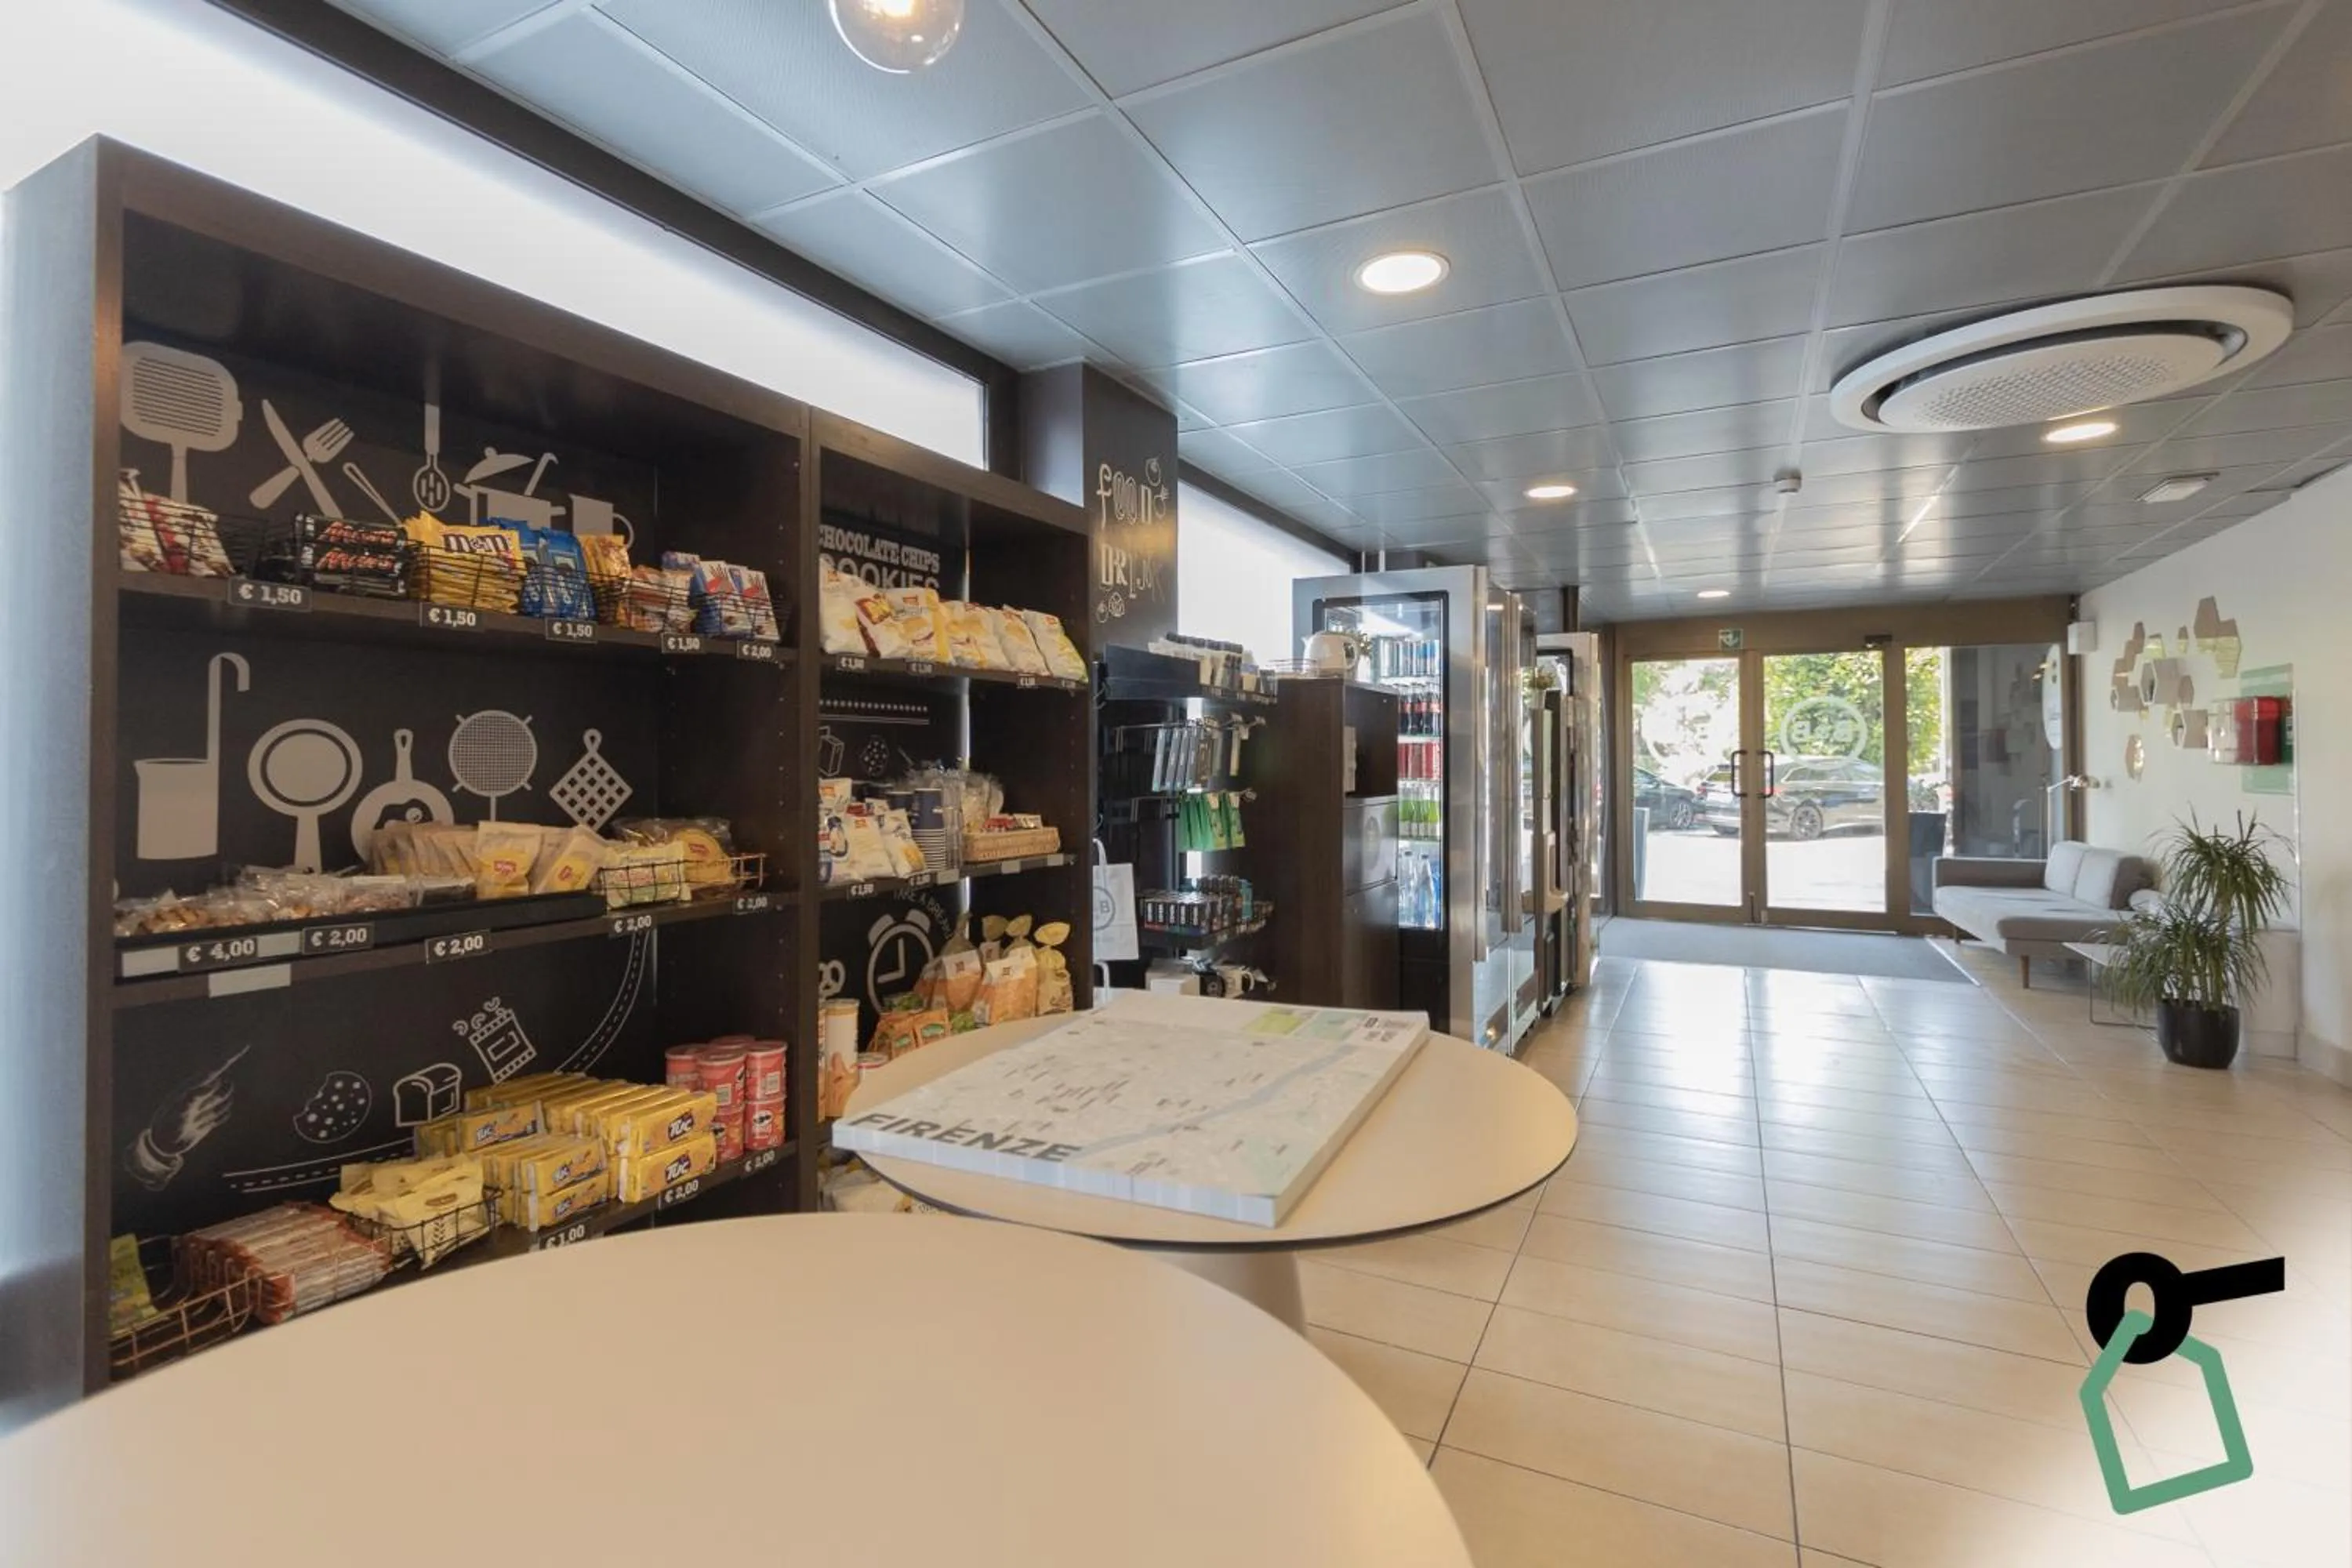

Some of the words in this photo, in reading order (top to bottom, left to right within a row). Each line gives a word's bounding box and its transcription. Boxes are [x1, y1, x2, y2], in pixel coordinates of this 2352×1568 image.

[819, 524, 899, 564] CHOCOLATE
[901, 544, 940, 575] CHIPS
[238, 583, 253, 599] €
[260, 586, 302, 605] 1,50
[429, 608, 440, 622] €
[444, 609, 476, 627] 1,50
[553, 622, 562, 634] €
[566, 623, 592, 638] 1,50
[667, 637, 676, 649] €
[614, 920, 622, 933] €
[626, 915, 652, 931] 2,00
[311, 931, 323, 946] €
[329, 927, 367, 946] 2,00
[434, 942, 445, 956] €
[450, 935, 483, 955] 2,00
[187, 946, 201, 962] €
[209, 938, 255, 961] 4,00
[849, 1112, 1082, 1162] FIRENZE
[665, 1189, 673, 1203] €
[676, 1179, 699, 1200] 2,00
